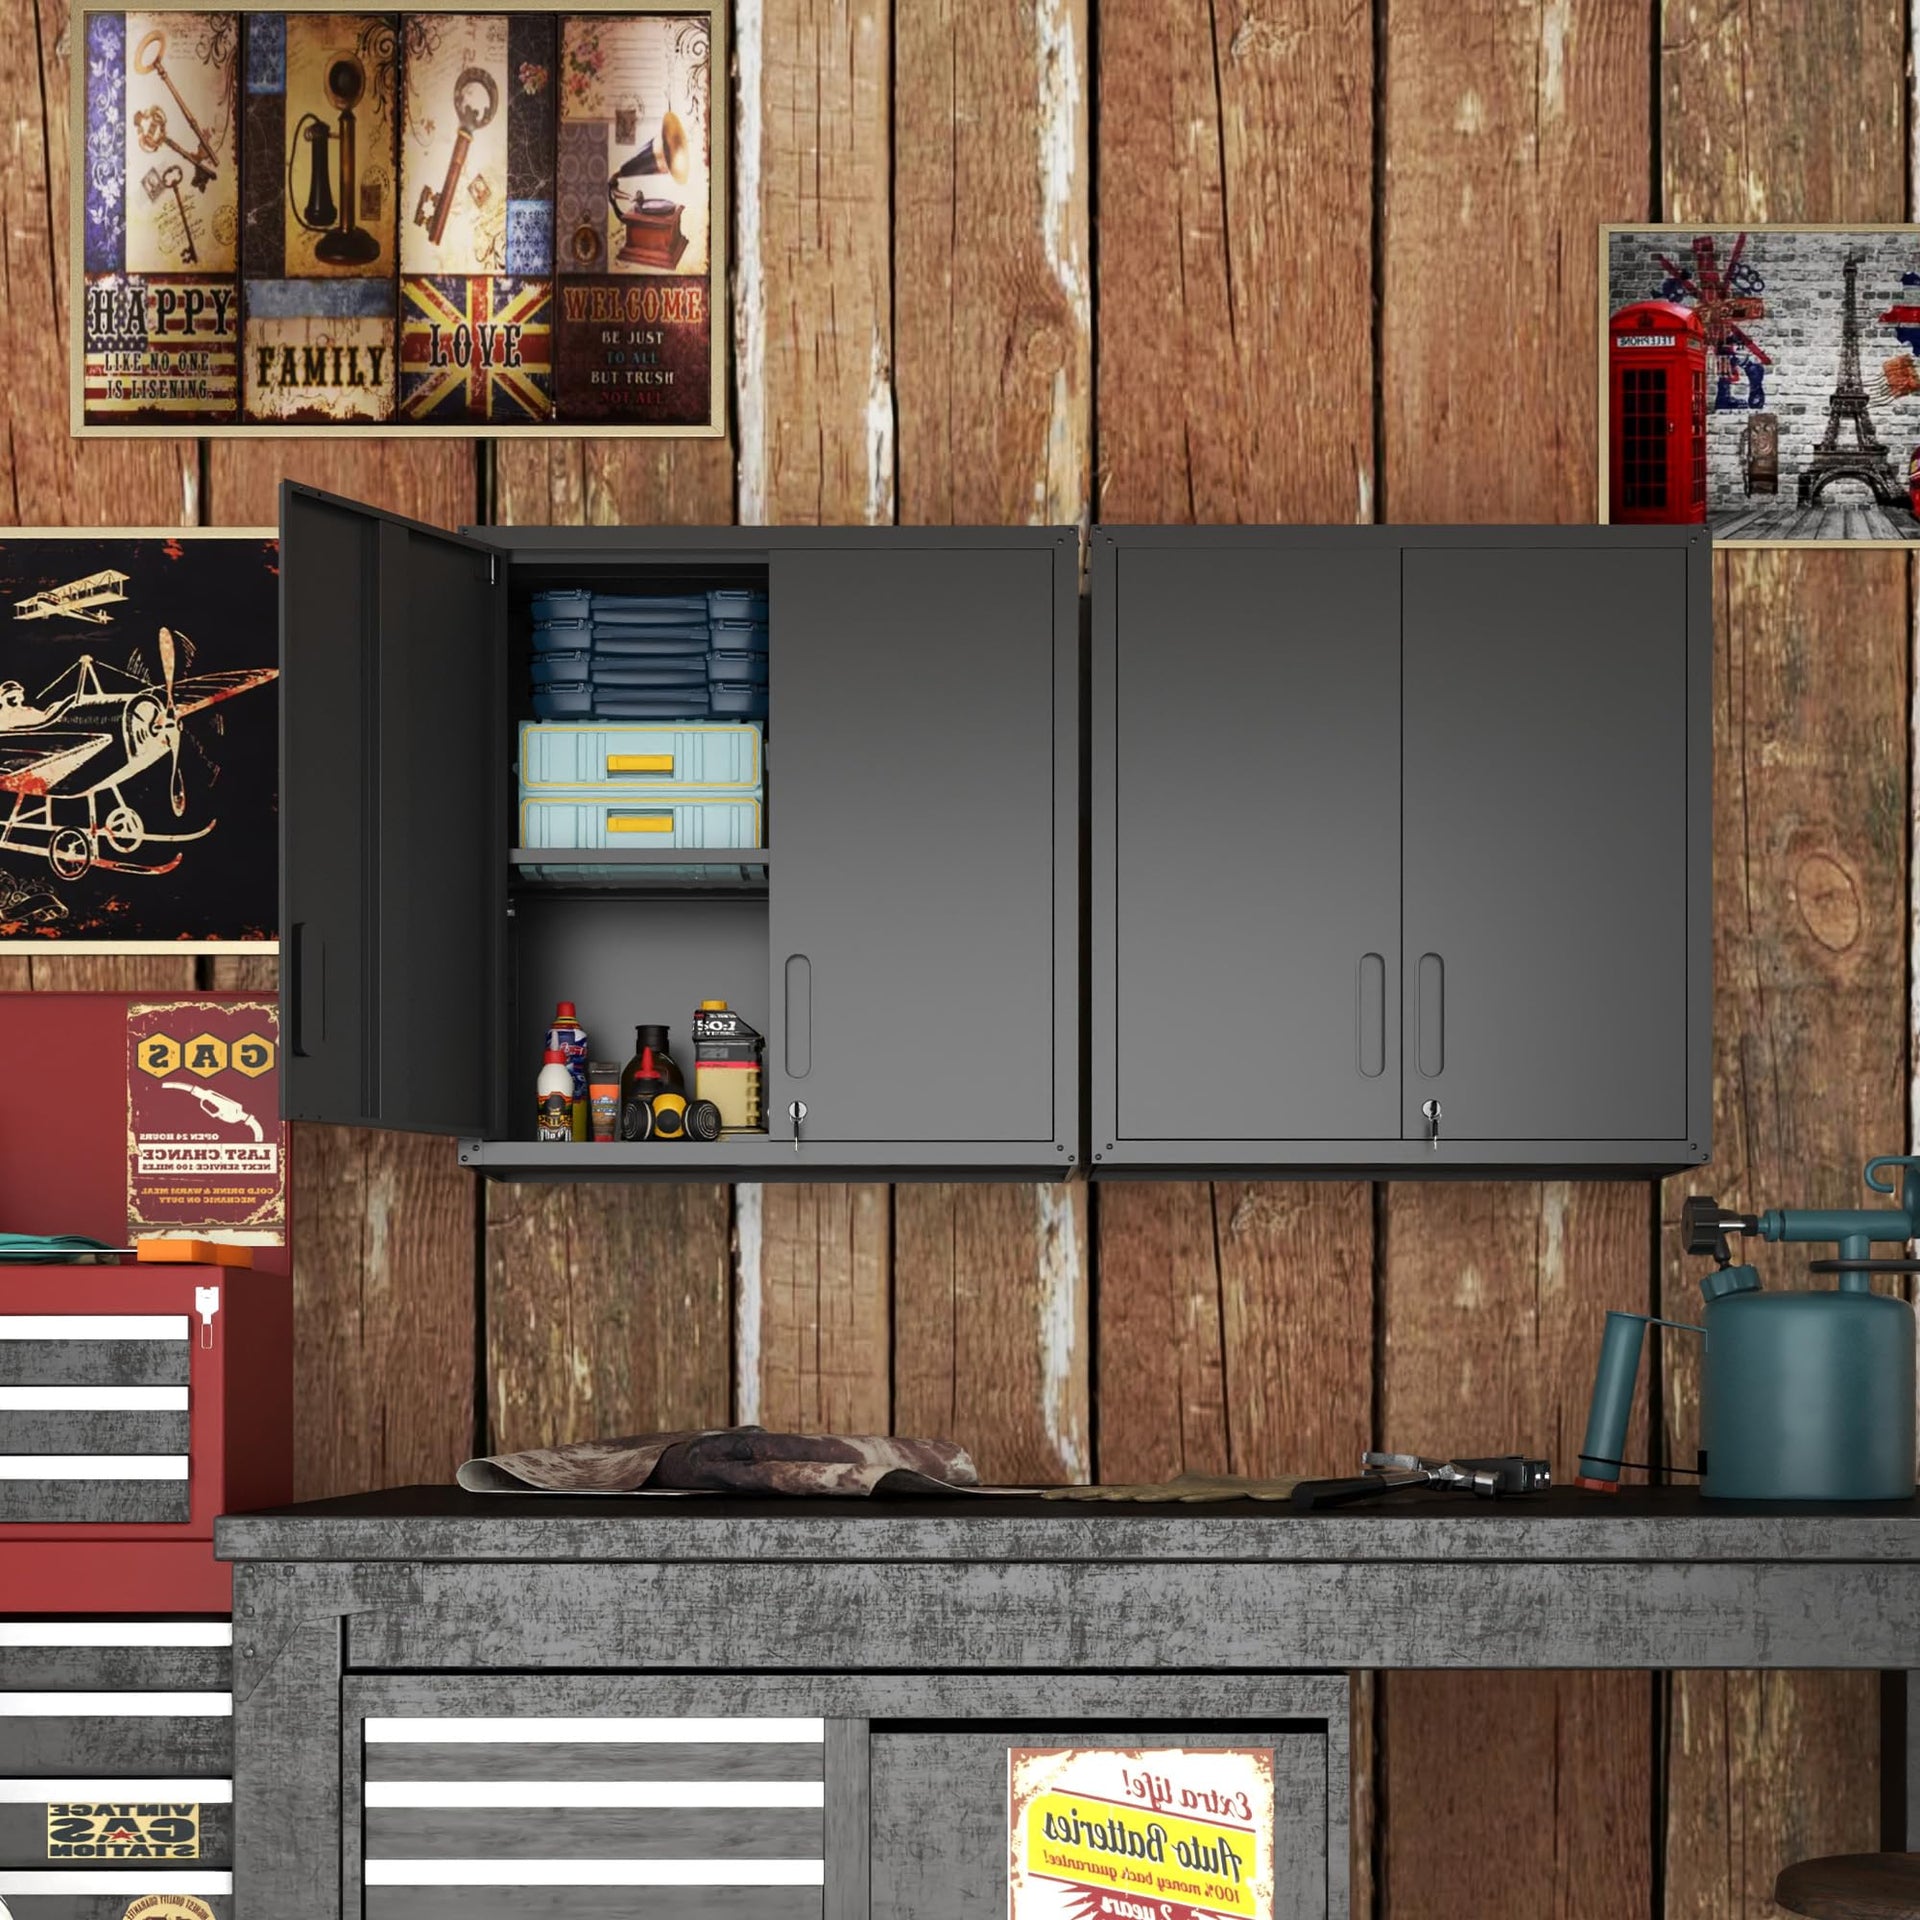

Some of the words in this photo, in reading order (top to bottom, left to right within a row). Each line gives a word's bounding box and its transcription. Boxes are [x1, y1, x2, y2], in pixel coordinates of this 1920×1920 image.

[90, 288, 232, 335] HAPPY
[563, 287, 703, 323] WELCOME
[429, 323, 522, 368] LOVE
[602, 331, 621, 345] BE
[627, 331, 664, 345] JUST
[105, 352, 142, 372] LIKE
[150, 352, 170, 372] NO
[178, 352, 210, 372] ONE
[257, 347, 385, 387] FAMILY
[607, 351, 625, 364] TO
[632, 351, 659, 364] ALL
[591, 371, 619, 385] BUT
[107, 380, 123, 399] IS
